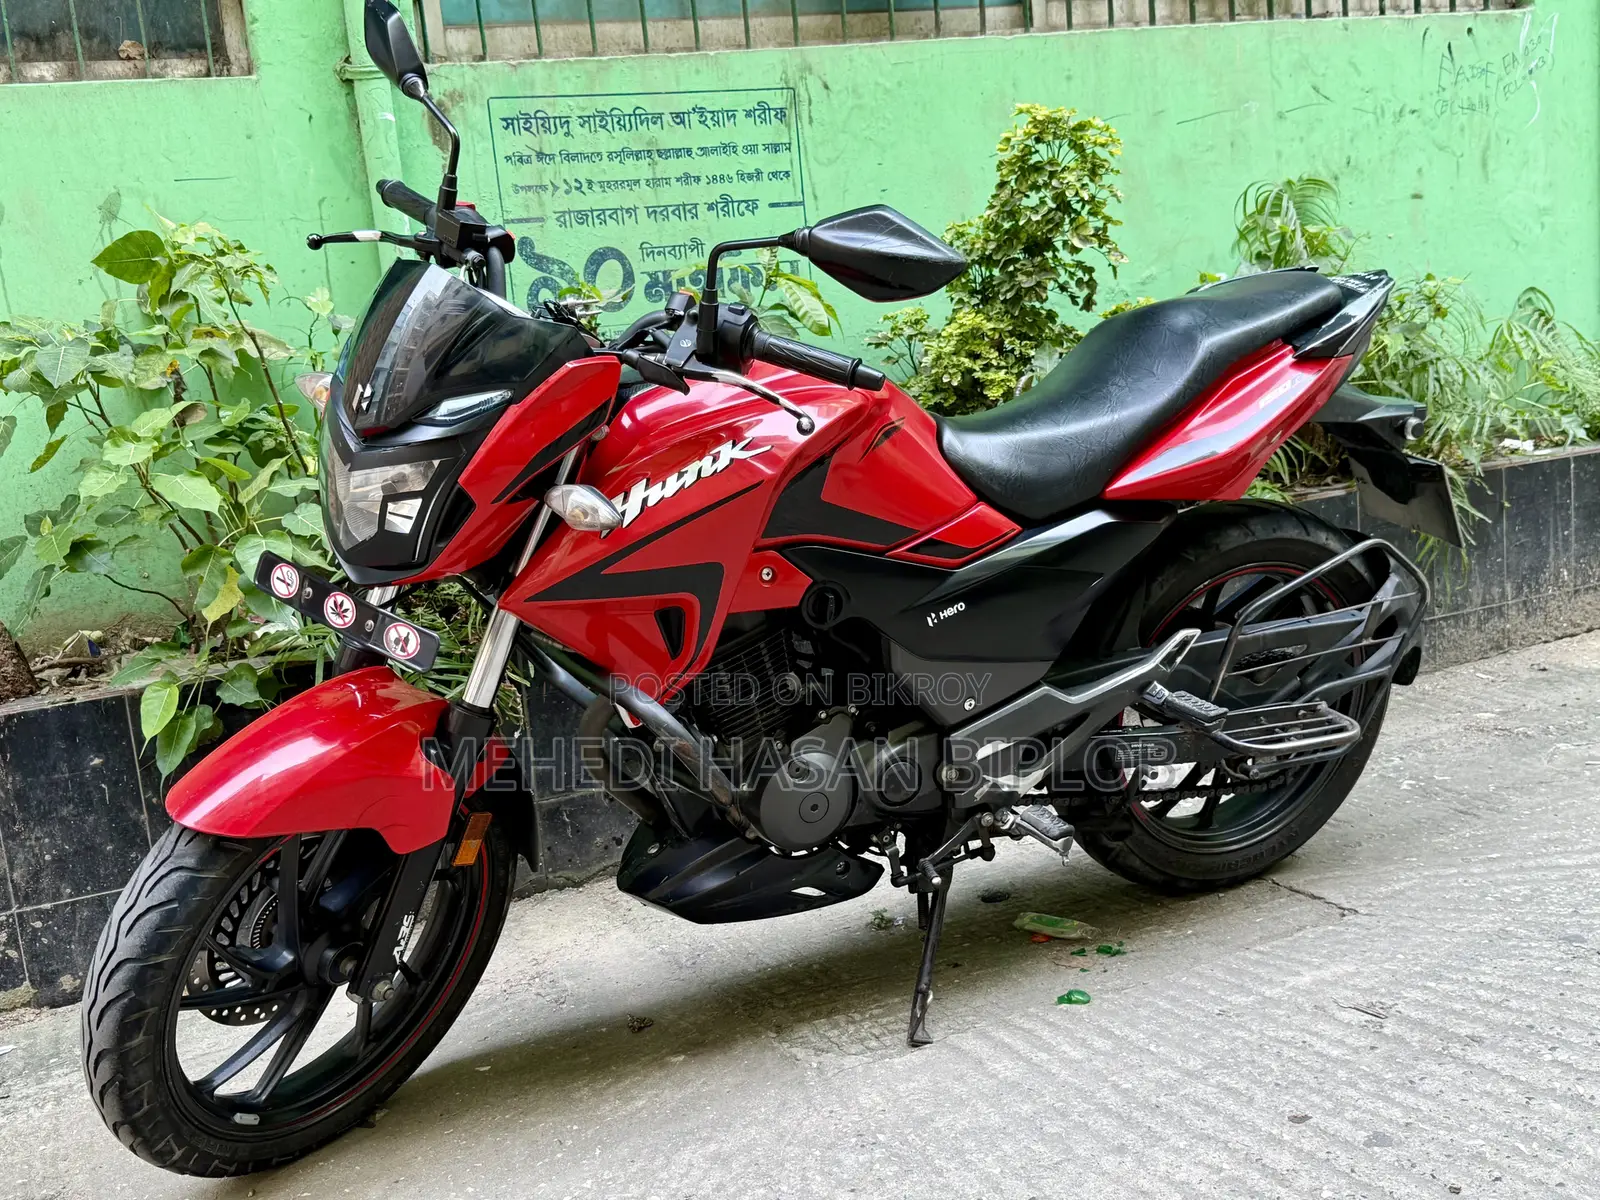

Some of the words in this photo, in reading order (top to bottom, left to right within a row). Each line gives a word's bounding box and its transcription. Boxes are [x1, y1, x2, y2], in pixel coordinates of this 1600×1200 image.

[742, 100, 788, 126] শরীফ
[504, 151, 533, 167] পবিত্র
[674, 171, 702, 188] শরীফ
[705, 174, 734, 186] ১৪৪৬
[736, 168, 764, 183] হিজরী
[767, 169, 791, 182] থেকে
[553, 204, 640, 229] রাজারবাগ
[644, 201, 700, 224] দরবার
[703, 193, 760, 220] শরীফে
[638, 237, 707, 263] দিনব্যাপী
[939, 601, 966, 620] Hero
